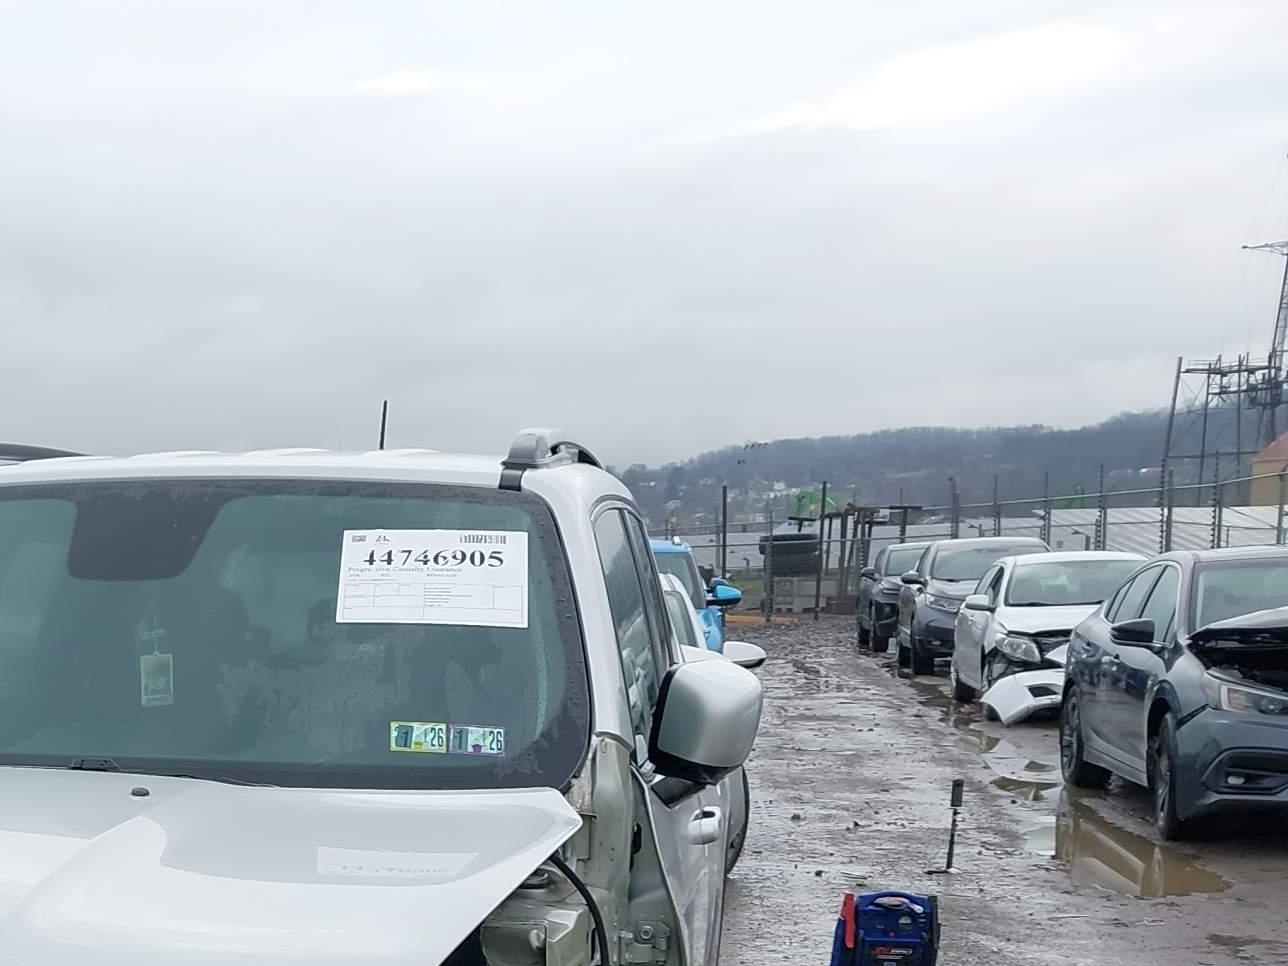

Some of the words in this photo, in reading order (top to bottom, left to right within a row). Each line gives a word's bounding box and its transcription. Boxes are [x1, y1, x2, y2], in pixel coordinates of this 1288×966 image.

[363, 549, 504, 567] 44746905
[430, 727, 444, 748] 26
[488, 730, 503, 751] 26
